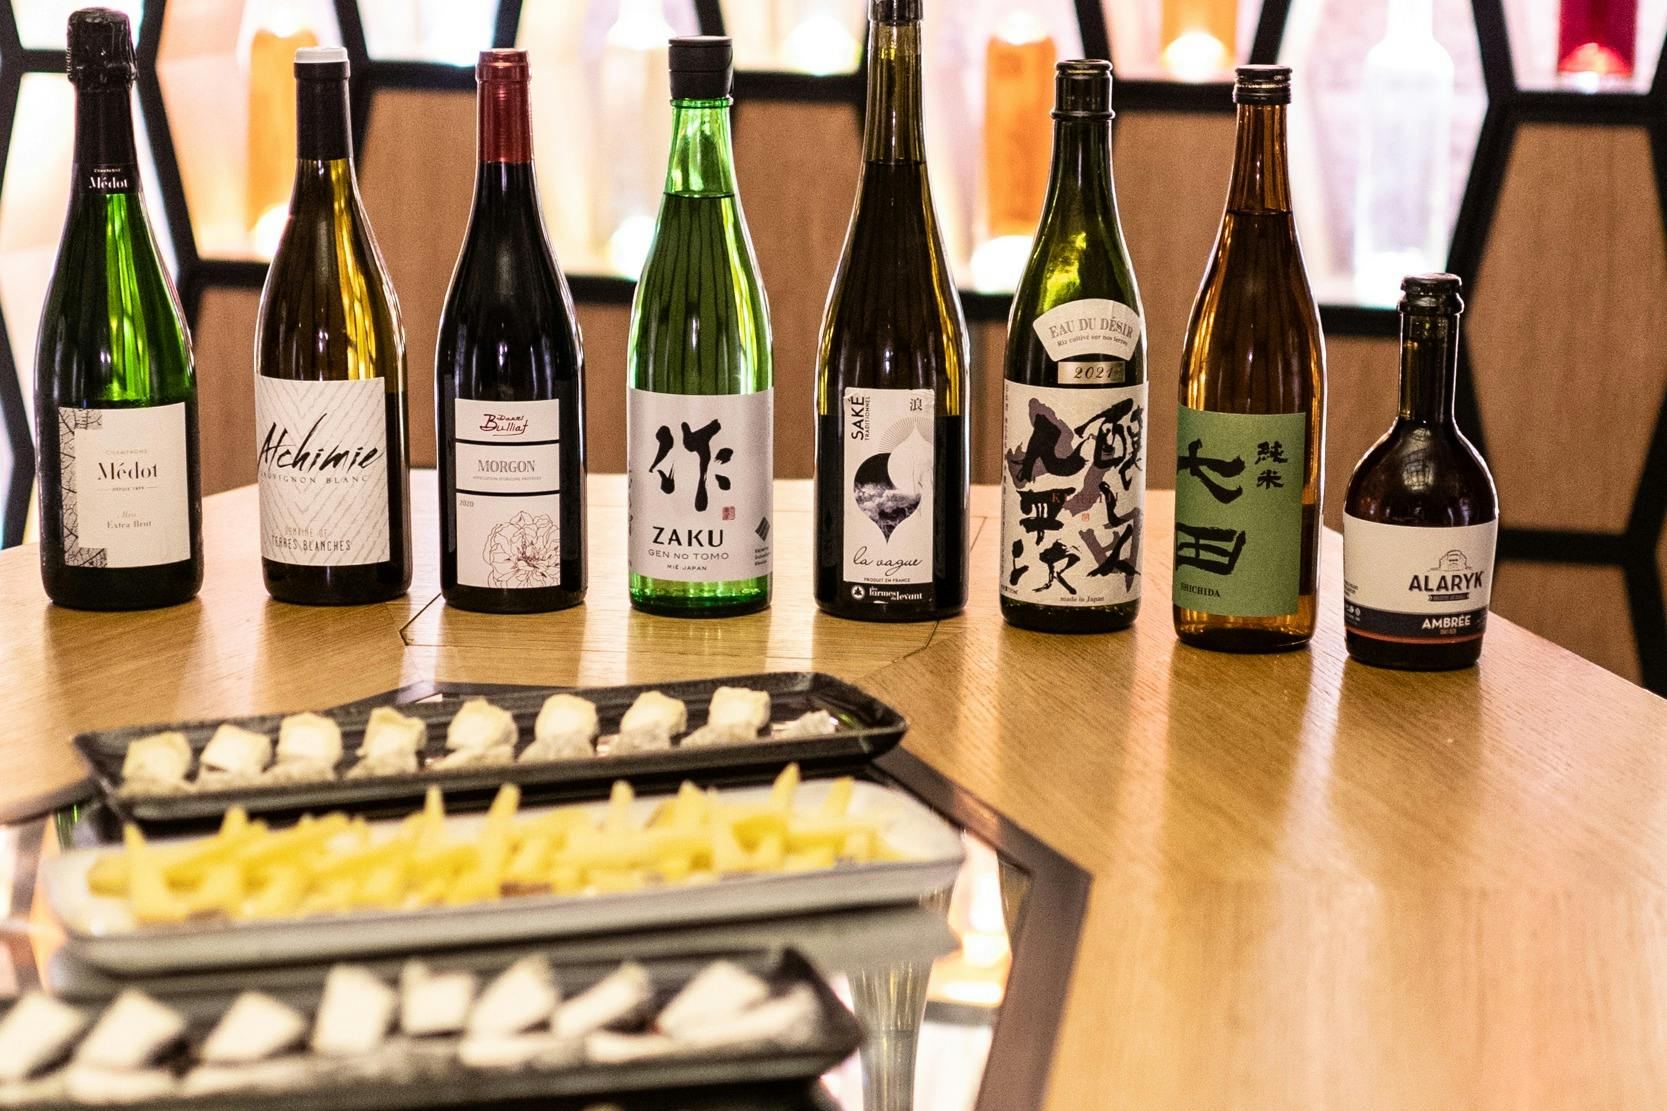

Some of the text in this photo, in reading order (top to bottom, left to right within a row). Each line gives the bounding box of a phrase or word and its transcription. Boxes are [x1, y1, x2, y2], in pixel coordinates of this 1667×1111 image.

[89, 176, 128, 189] Médot
[1049, 316, 1134, 339] EAU DU DÉSIR
[1073, 366, 1114, 379] 2021
[847, 396, 865, 441] SAKÉ
[97, 461, 157, 480] Médot
[478, 459, 536, 473] MORGON
[649, 418, 734, 513] 作
[1255, 441, 1288, 490] 純米
[326, 474, 369, 484] BLANC
[459, 499, 475, 507] 2020
[107, 520, 152, 529] Extra Brut
[652, 526, 724, 548] ZAKU
[302, 539, 352, 552] BLANCHES
[648, 548, 730, 561] GEN NO TOMO
[853, 545, 923, 577] la vague
[1408, 571, 1484, 592] ALARYK
[896, 591, 923, 601] levant
[1180, 582, 1221, 598] SHICHIDA
[1086, 595, 1105, 603] Japan
[1421, 614, 1472, 630] AMBRÉE
